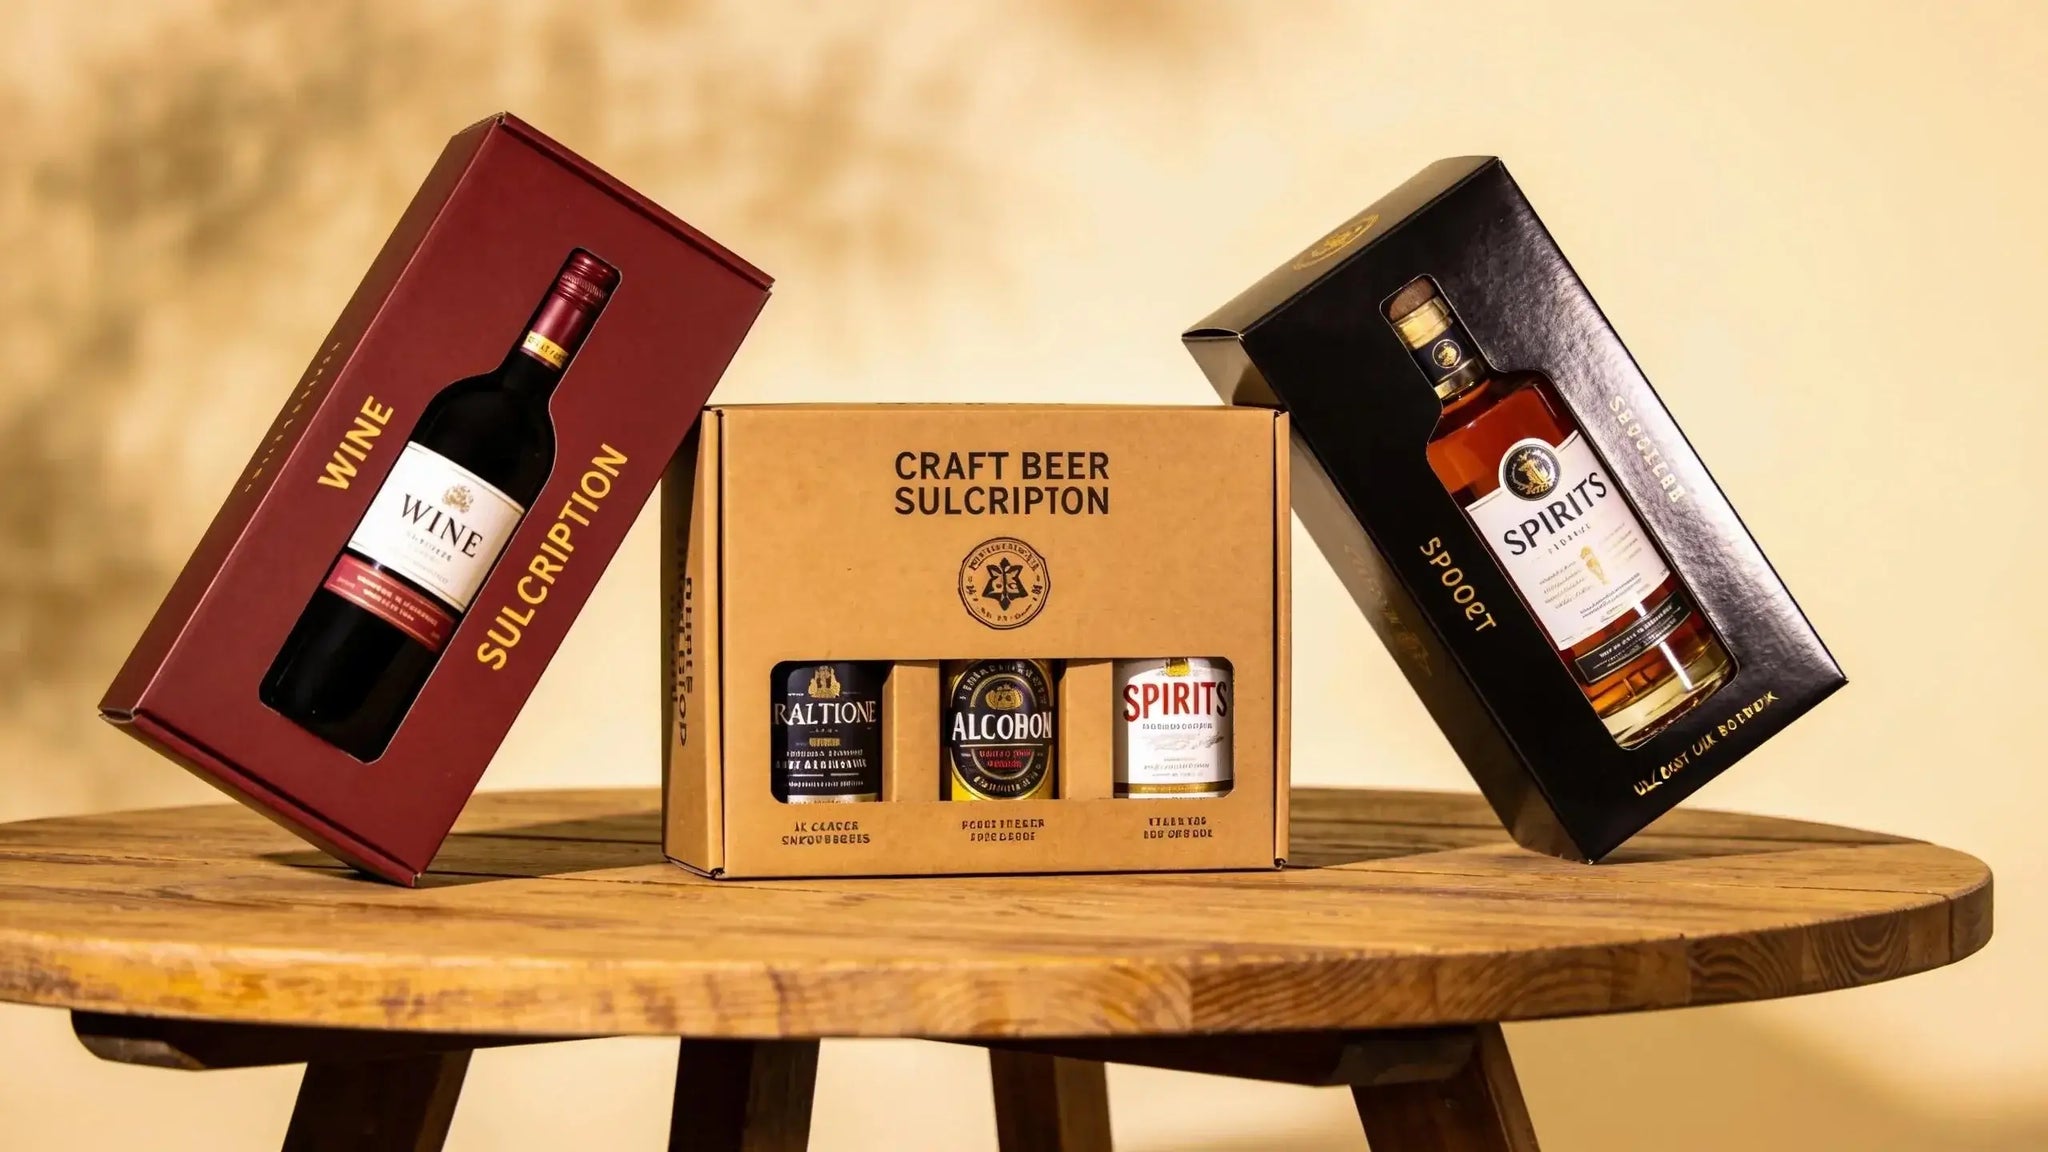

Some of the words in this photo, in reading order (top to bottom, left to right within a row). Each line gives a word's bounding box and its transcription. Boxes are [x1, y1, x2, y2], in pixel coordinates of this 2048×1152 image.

[317, 395, 394, 489] WINE
[895, 451, 1009, 480] CRAFT
[1022, 451, 1110, 480] BEER
[401, 493, 483, 558] WINE
[894, 486, 1109, 515] SULCRIPTON
[1503, 472, 1607, 556] SPIRITS
[477, 443, 628, 670] SULCRIPTION
[774, 700, 877, 726] RALTIONE
[1122, 681, 1228, 723] SPIRITS
